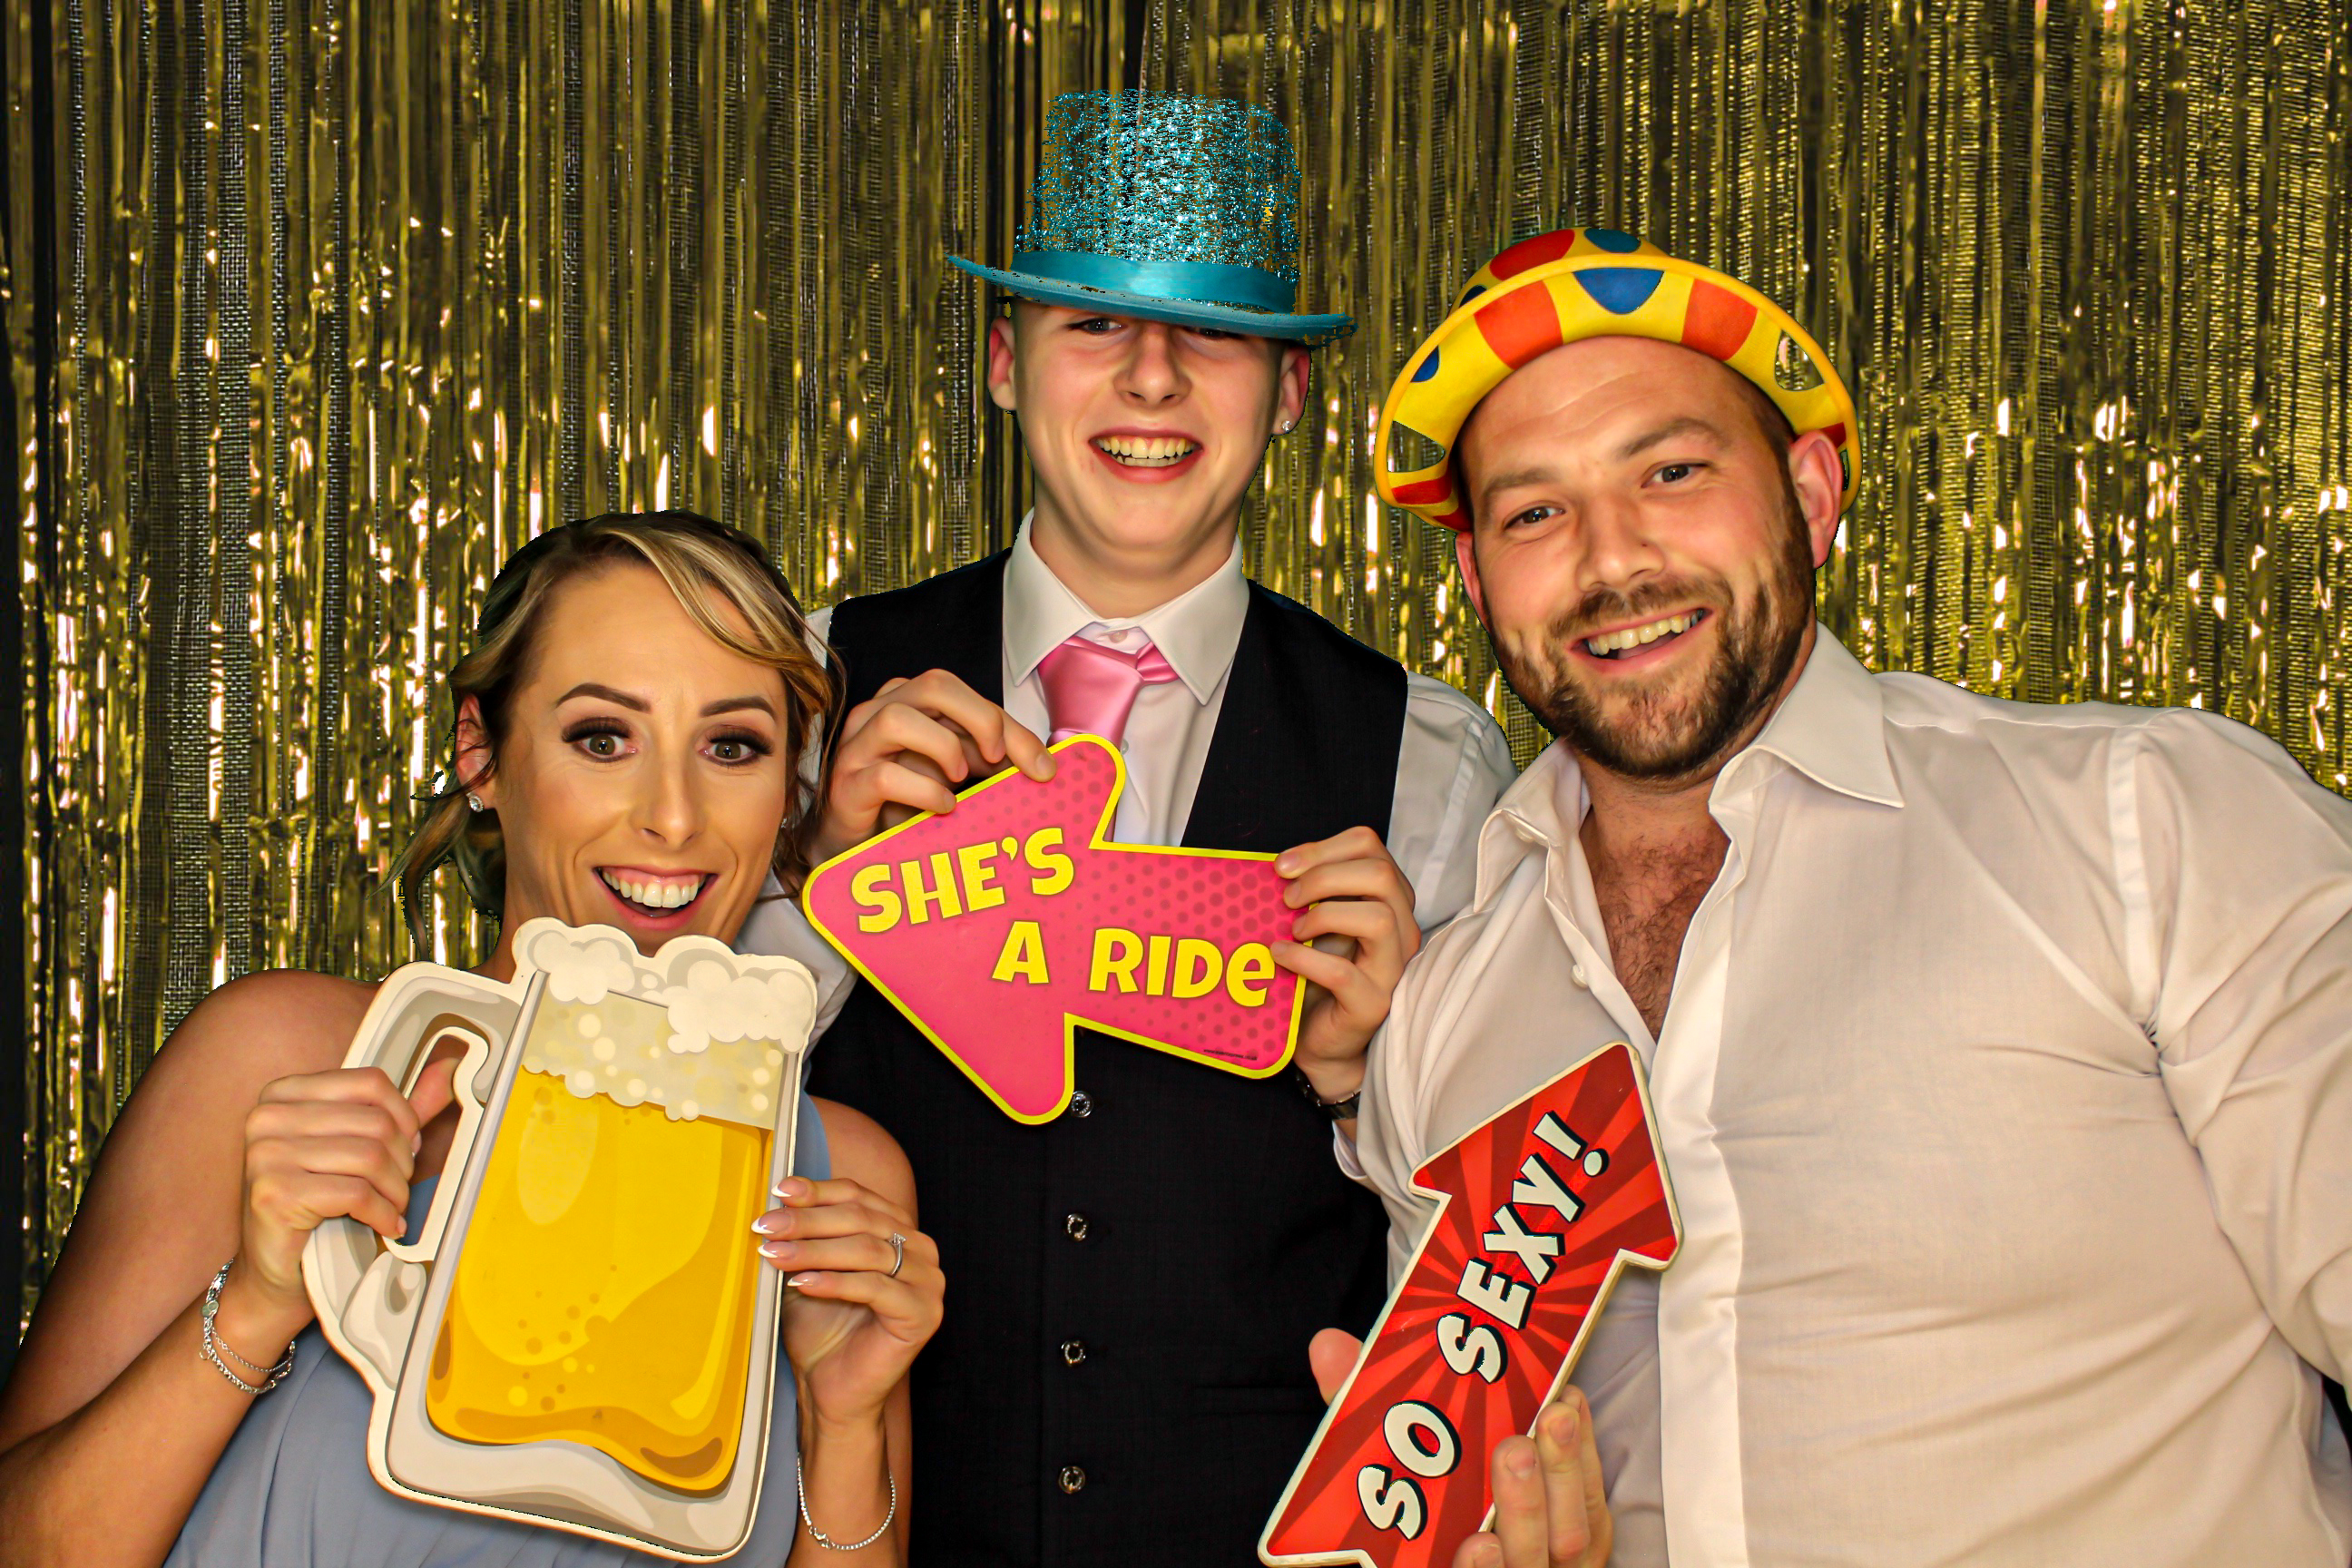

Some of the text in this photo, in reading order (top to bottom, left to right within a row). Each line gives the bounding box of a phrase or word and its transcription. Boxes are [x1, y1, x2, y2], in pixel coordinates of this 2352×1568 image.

[850, 828, 1074, 933] SHE'S
[991, 920, 1049, 984] A
[1357, 1111, 1610, 1541] SO SEXY!
